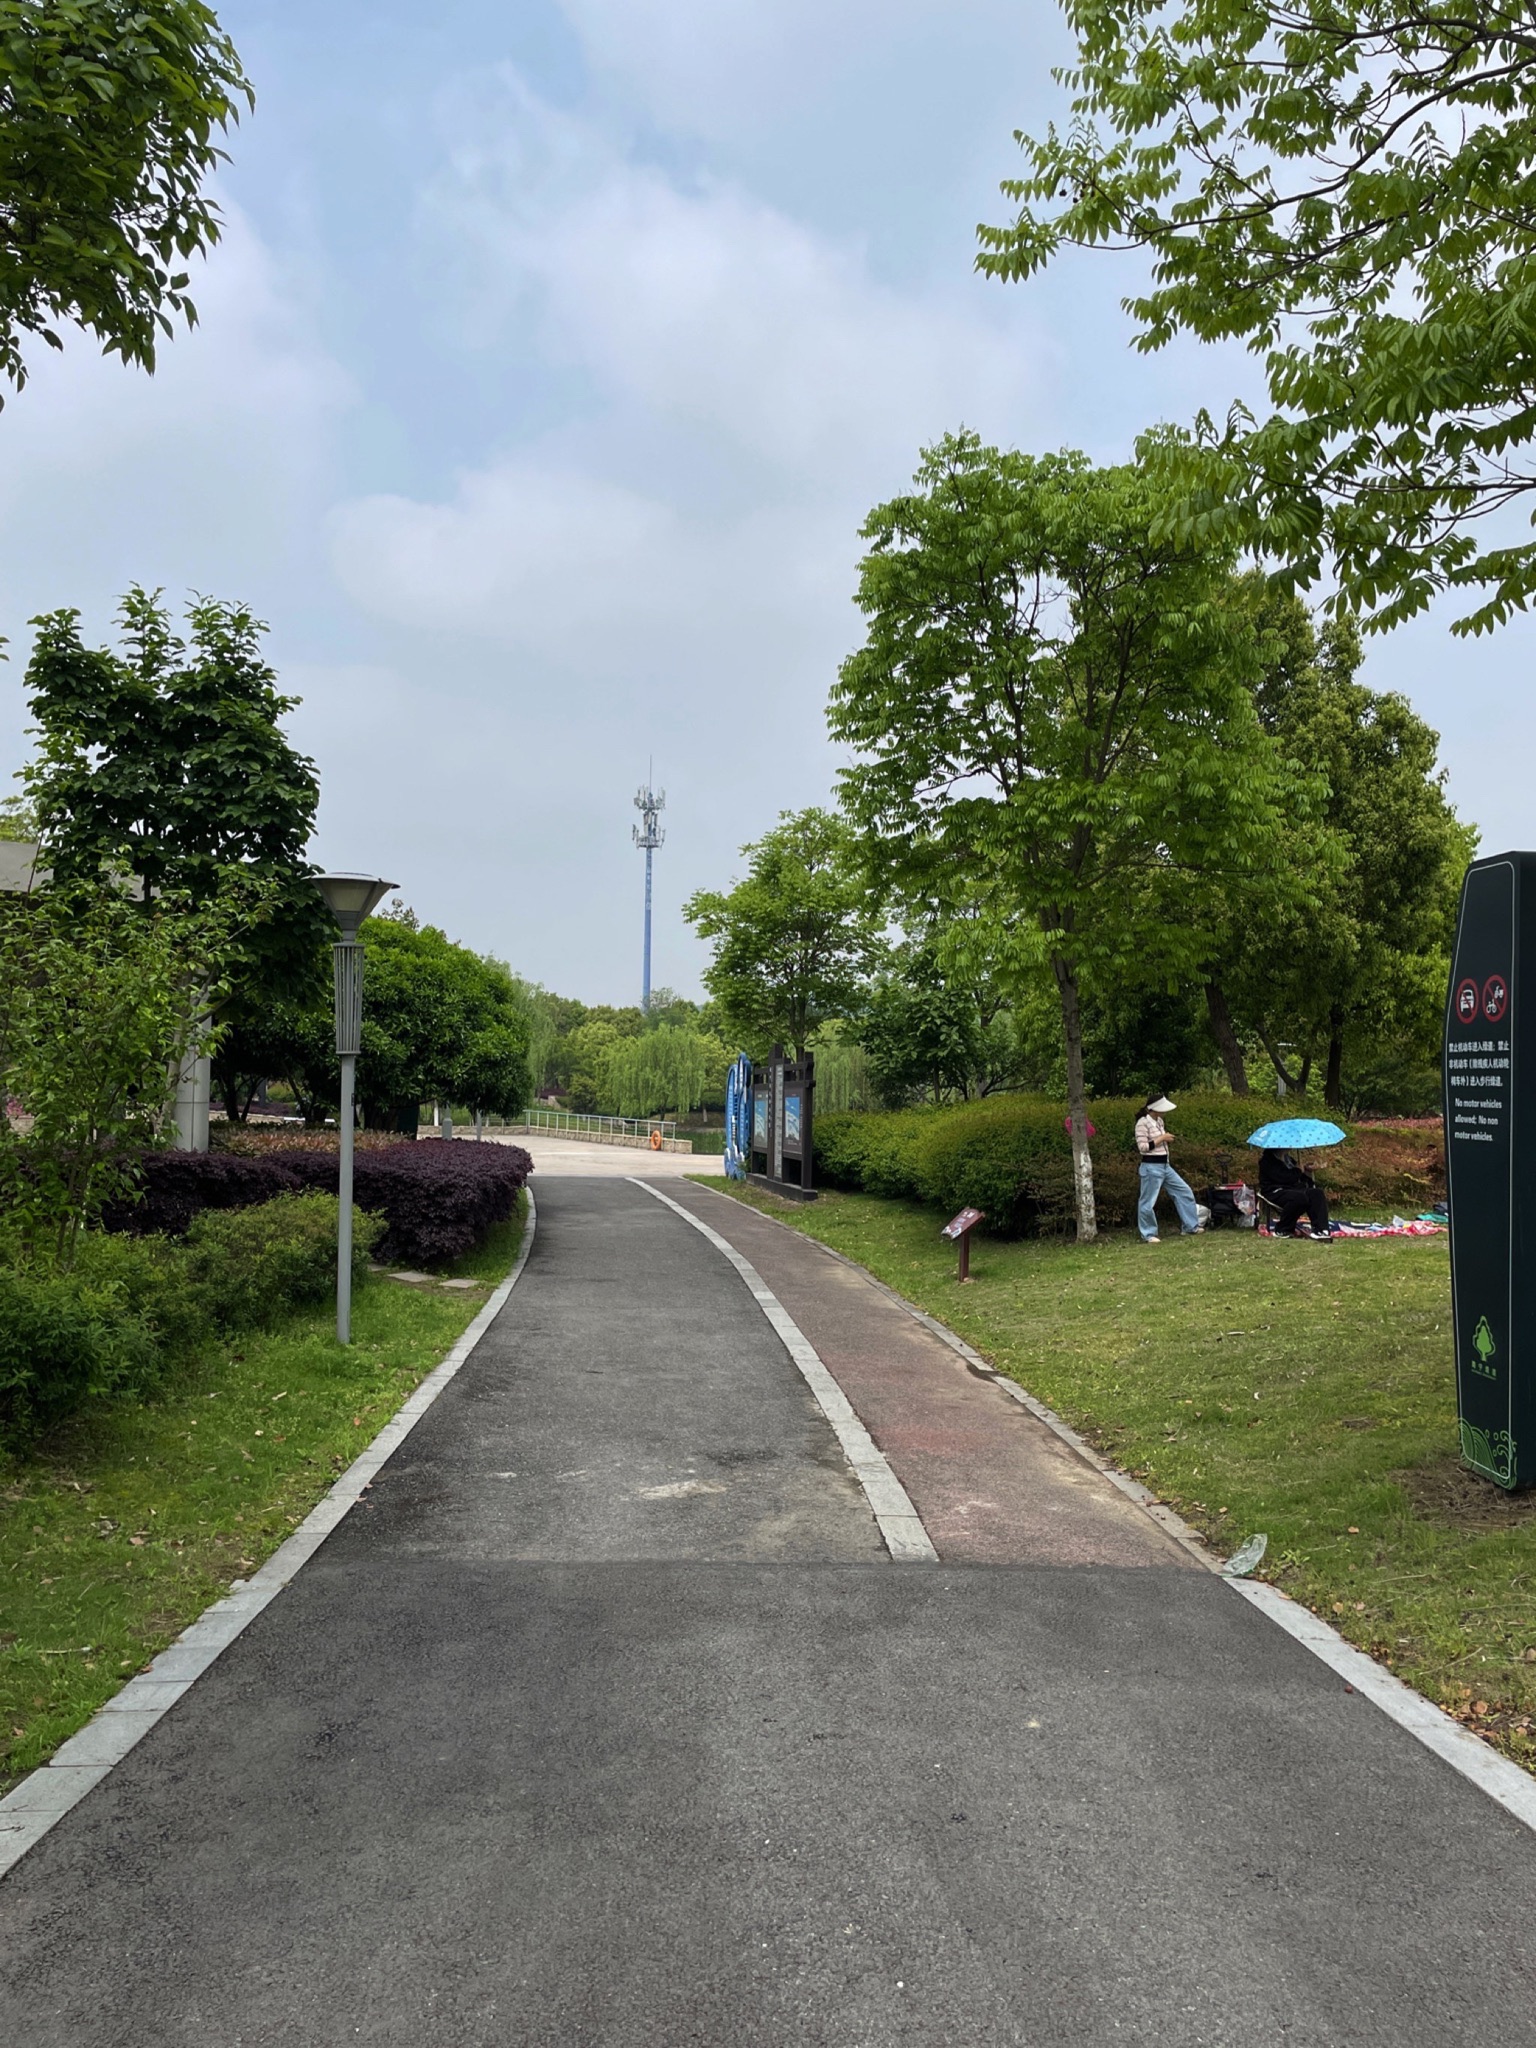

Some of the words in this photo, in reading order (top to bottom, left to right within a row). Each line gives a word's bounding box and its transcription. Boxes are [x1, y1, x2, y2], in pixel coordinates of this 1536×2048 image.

[1455, 1098, 1462, 1107] No
[1463, 1100, 1479, 1108] motor
[1480, 1099, 1502, 1109] vehicles
[1478, 1115, 1487, 1125] No
[1487, 1117, 1499, 1125] non
[1454, 1131, 1470, 1139] motor
